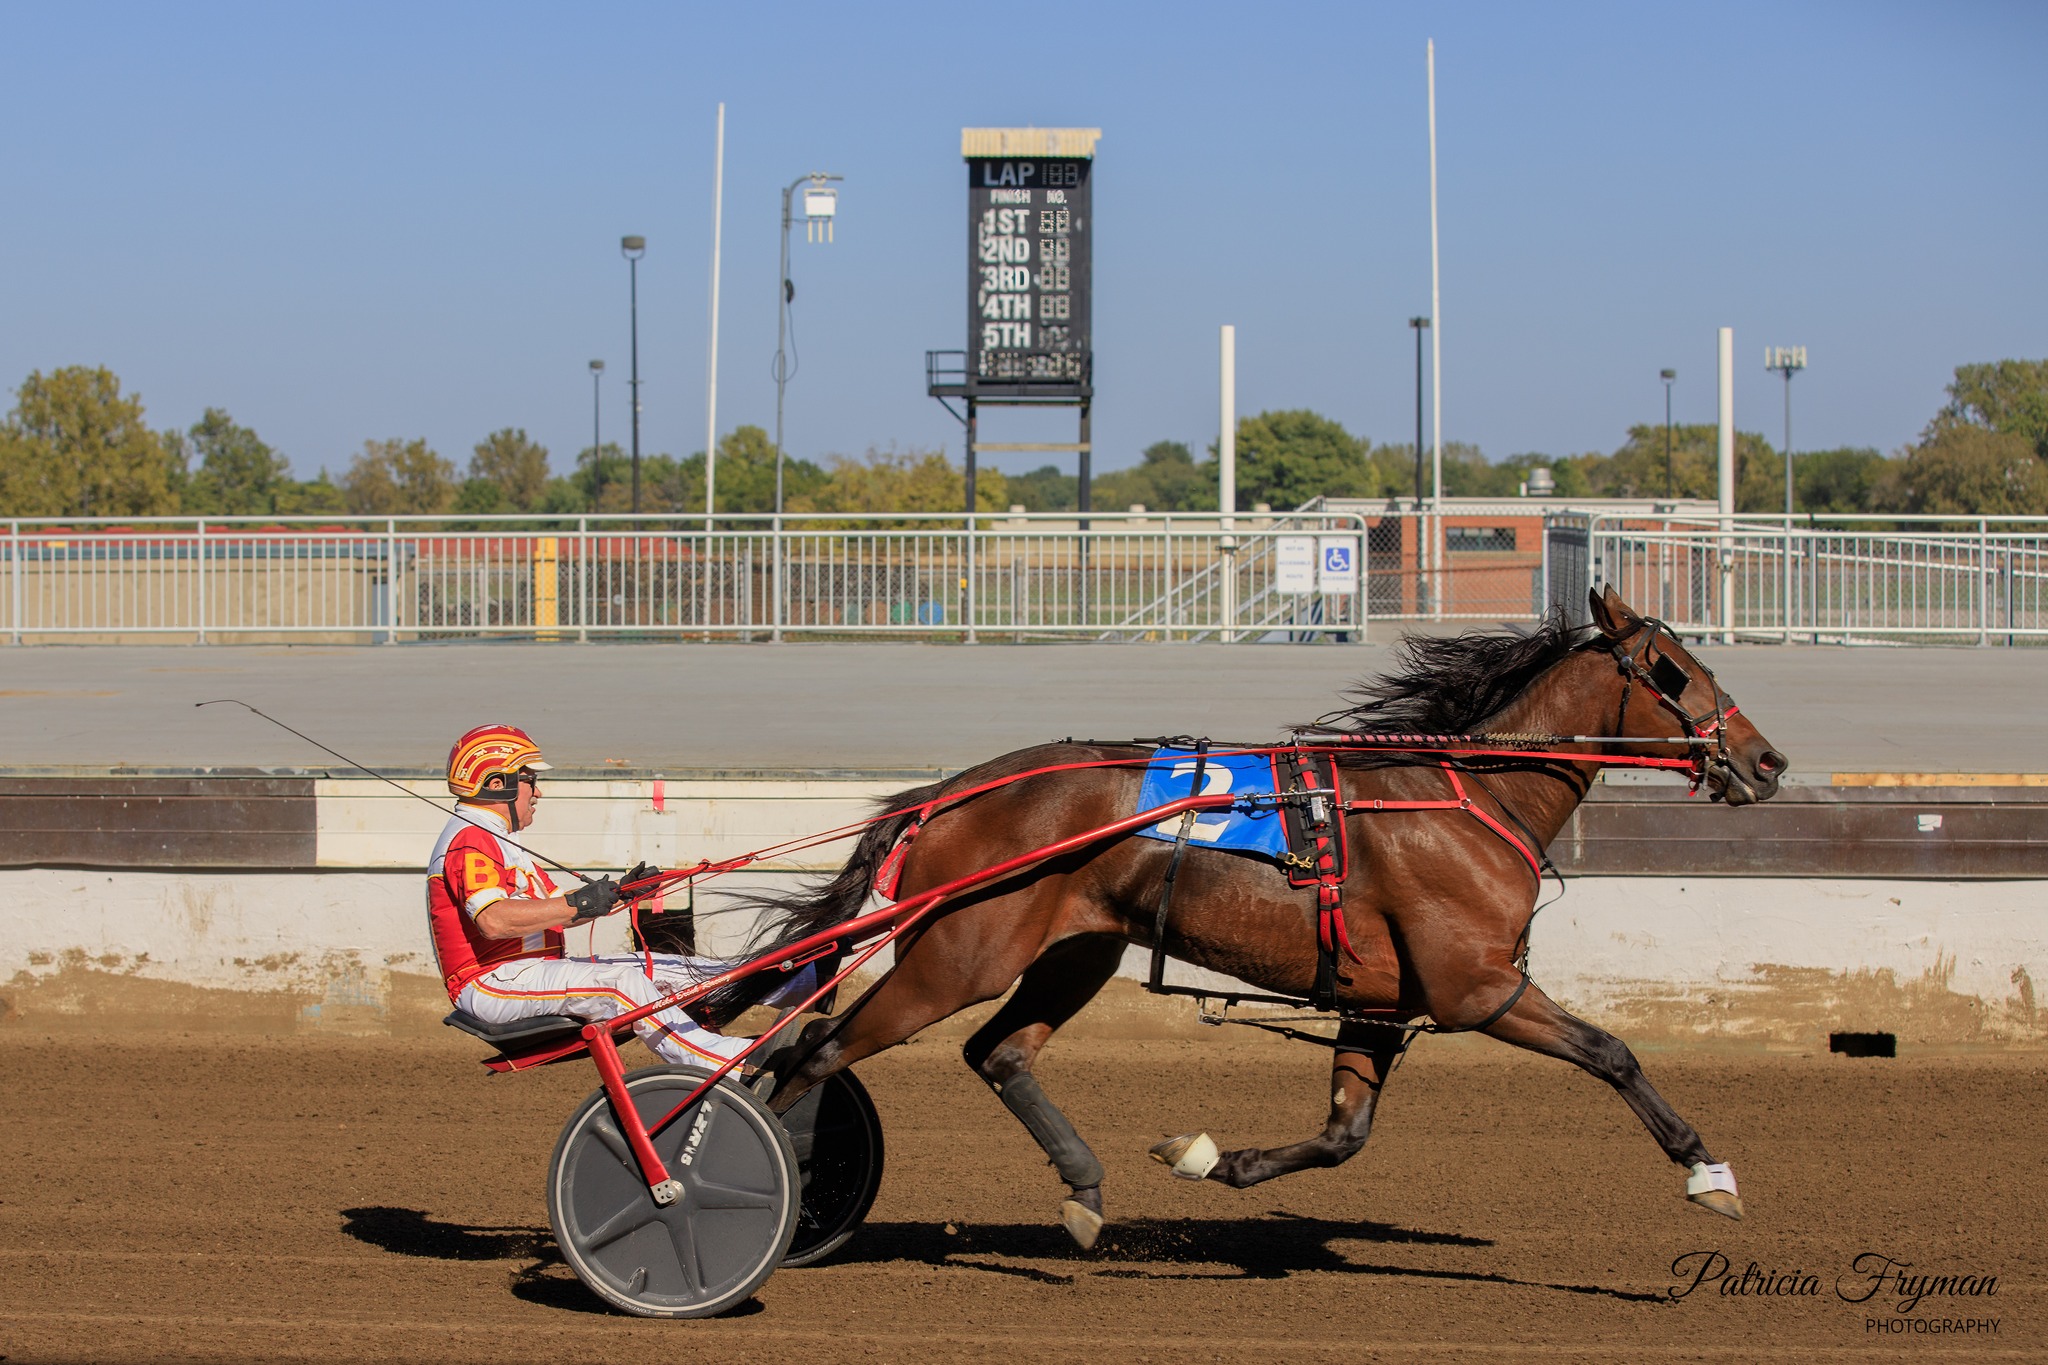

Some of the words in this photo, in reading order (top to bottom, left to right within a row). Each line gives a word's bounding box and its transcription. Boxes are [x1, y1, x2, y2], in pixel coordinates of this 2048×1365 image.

[984, 162, 1035, 186] LAP
[1046, 190, 1067, 204] NO.
[983, 208, 1030, 234] 1ST
[983, 237, 1030, 263] 2ND
[983, 266, 1030, 292] 3RD
[982, 293, 1031, 319] 4TH
[984, 322, 1031, 348] 5TH
[1156, 762, 1233, 842] 2
[465, 852, 500, 890] B
